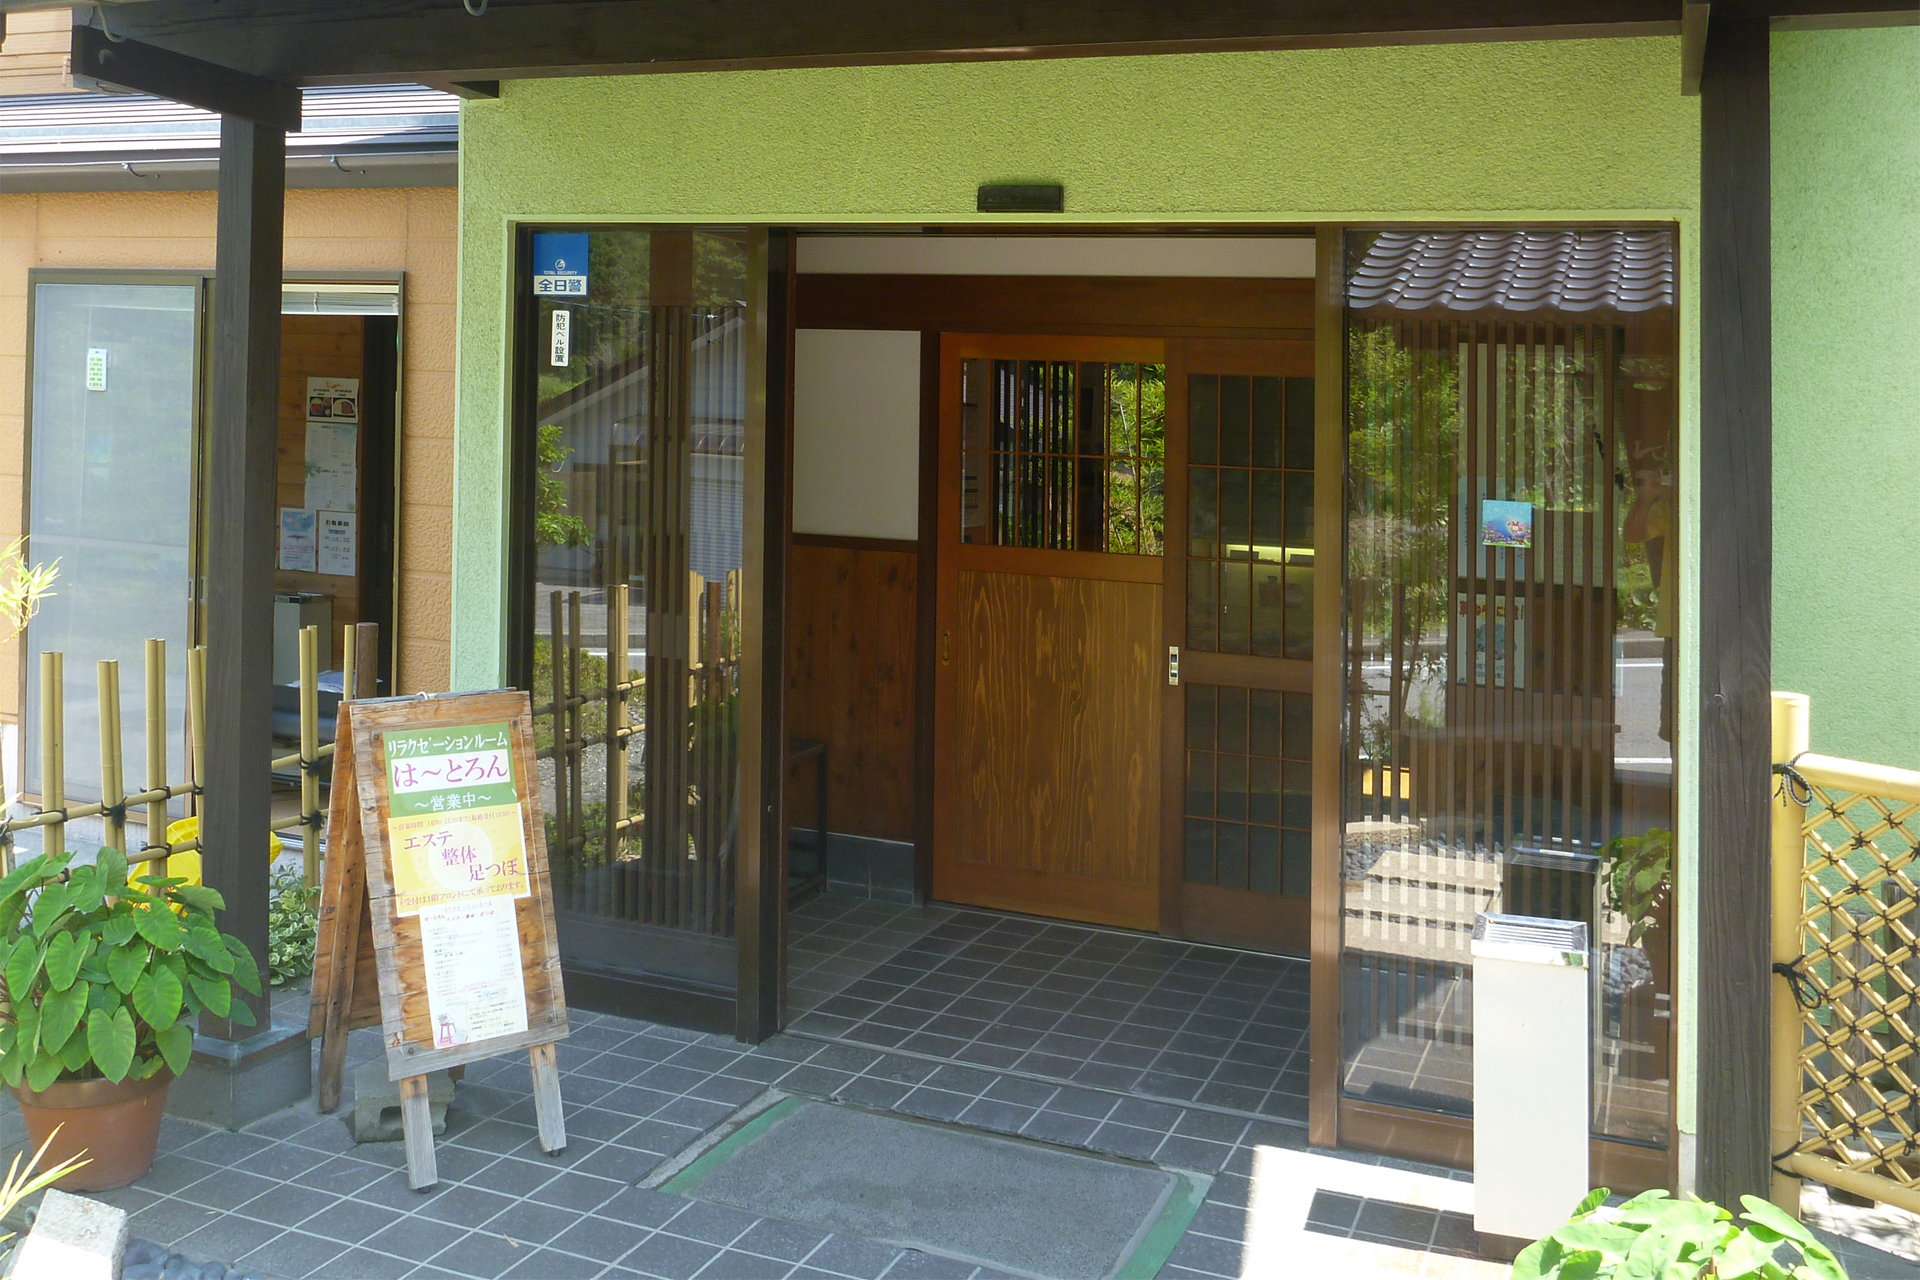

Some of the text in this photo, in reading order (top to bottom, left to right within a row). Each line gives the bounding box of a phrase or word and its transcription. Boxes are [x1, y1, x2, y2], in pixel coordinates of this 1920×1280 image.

[538, 278, 582, 292] 全日警
[555, 313, 566, 363] 防犯ベル設置
[388, 731, 508, 758] リラクゼーションルーム
[404, 830, 453, 850] エステ
[442, 845, 477, 866] 整体
[469, 857, 519, 883] 足つぼ
